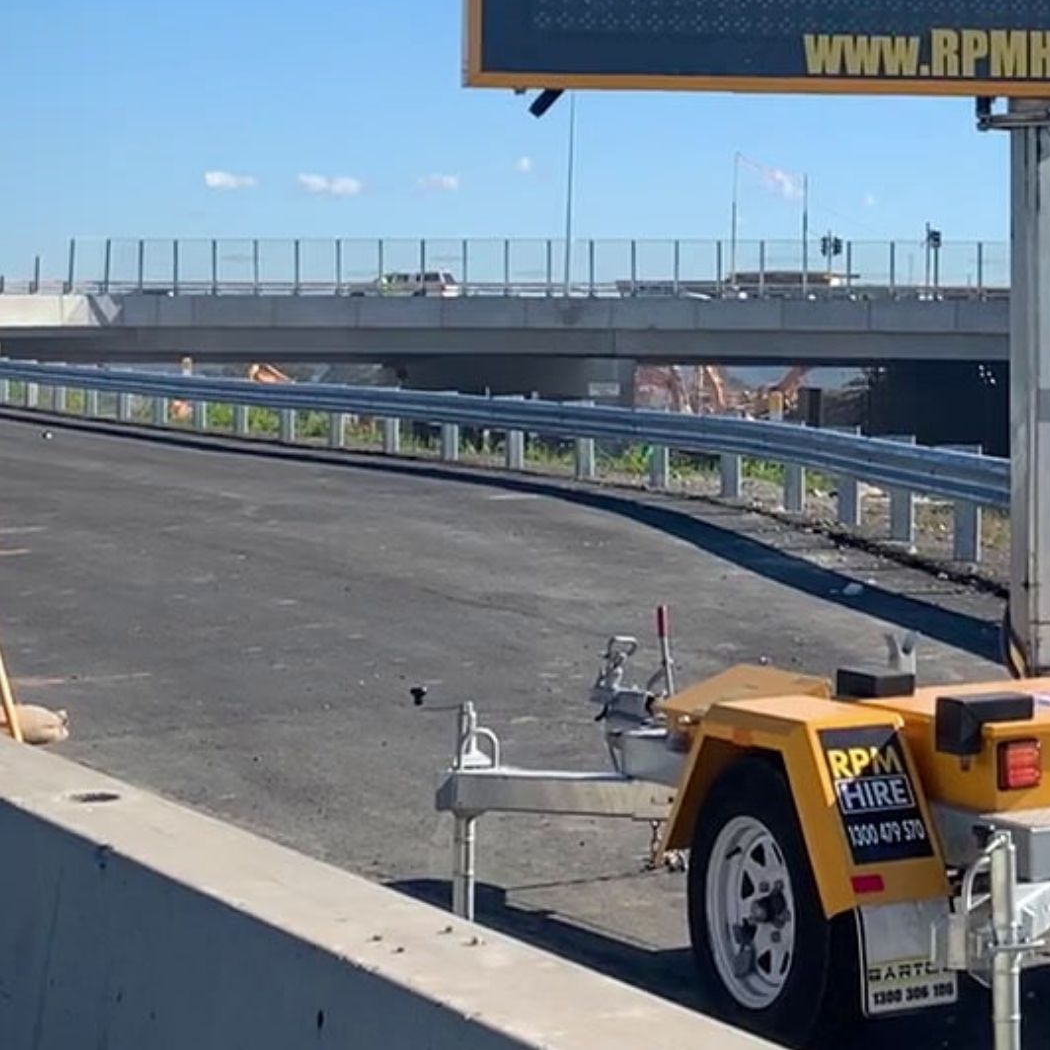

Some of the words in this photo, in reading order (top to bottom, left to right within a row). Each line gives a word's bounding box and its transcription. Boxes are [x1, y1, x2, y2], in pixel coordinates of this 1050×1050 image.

[827, 745, 903, 778] RPM
[840, 779, 908, 809] HIRE
[848, 823, 879, 846] 1300
[902, 818, 925, 841] 570
[868, 961, 940, 982] BARTC
